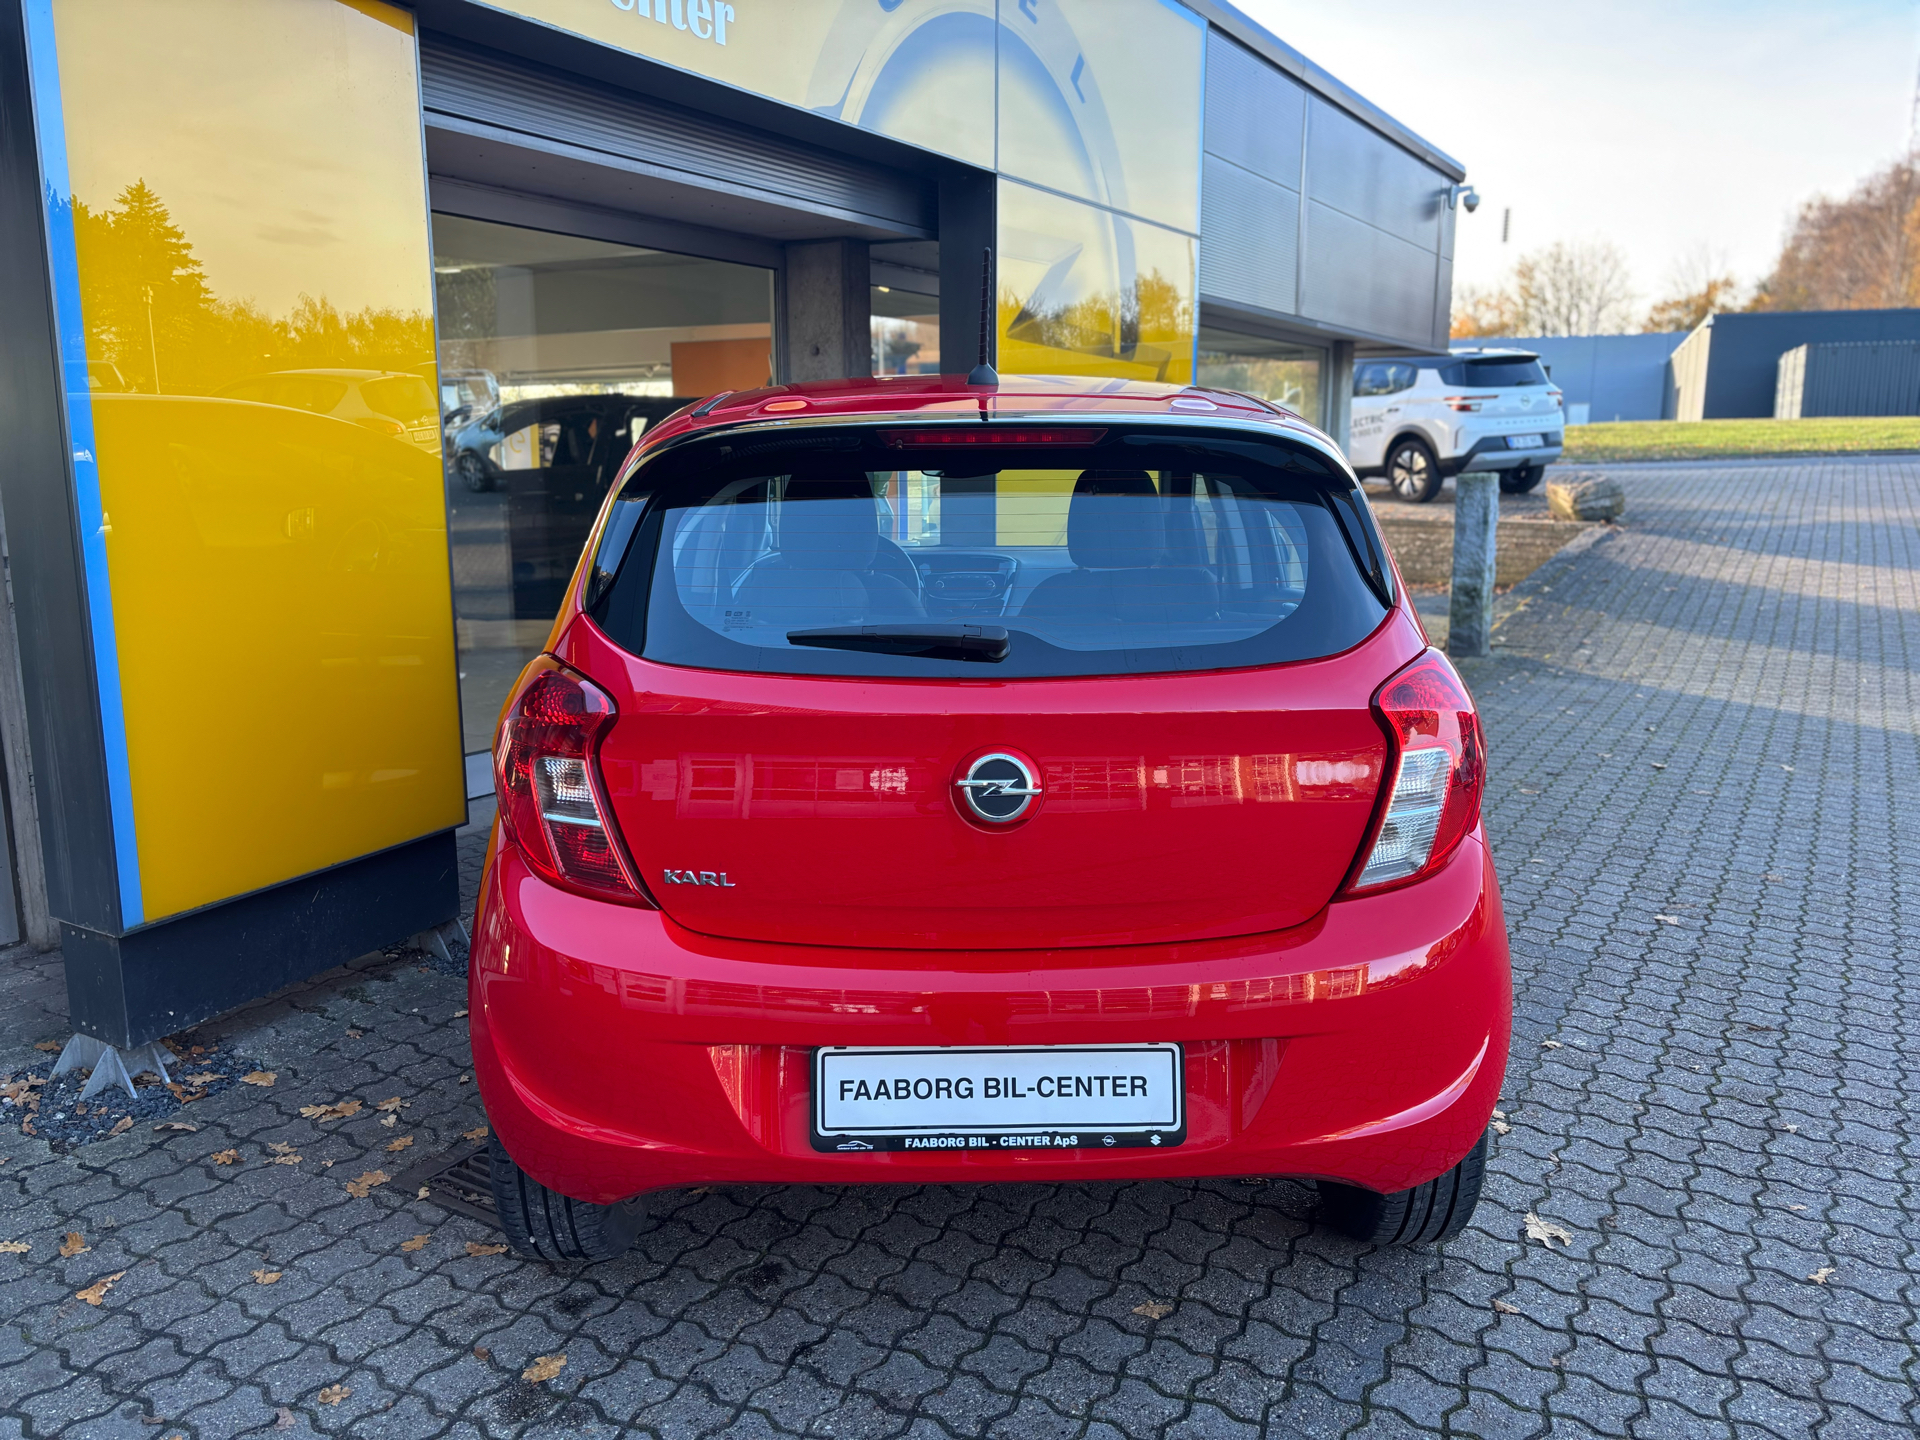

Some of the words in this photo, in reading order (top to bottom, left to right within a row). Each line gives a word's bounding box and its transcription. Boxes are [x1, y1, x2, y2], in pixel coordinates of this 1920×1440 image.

[663, 868, 736, 887] KARL
[839, 1076, 974, 1101] FAABORG
[984, 1075, 1148, 1099] BIL-CENTER
[904, 1137, 965, 1148] FAABORG
[968, 1136, 990, 1147] BIL
[999, 1136, 1051, 1147] CENTER
[1053, 1135, 1078, 1148] ApS
